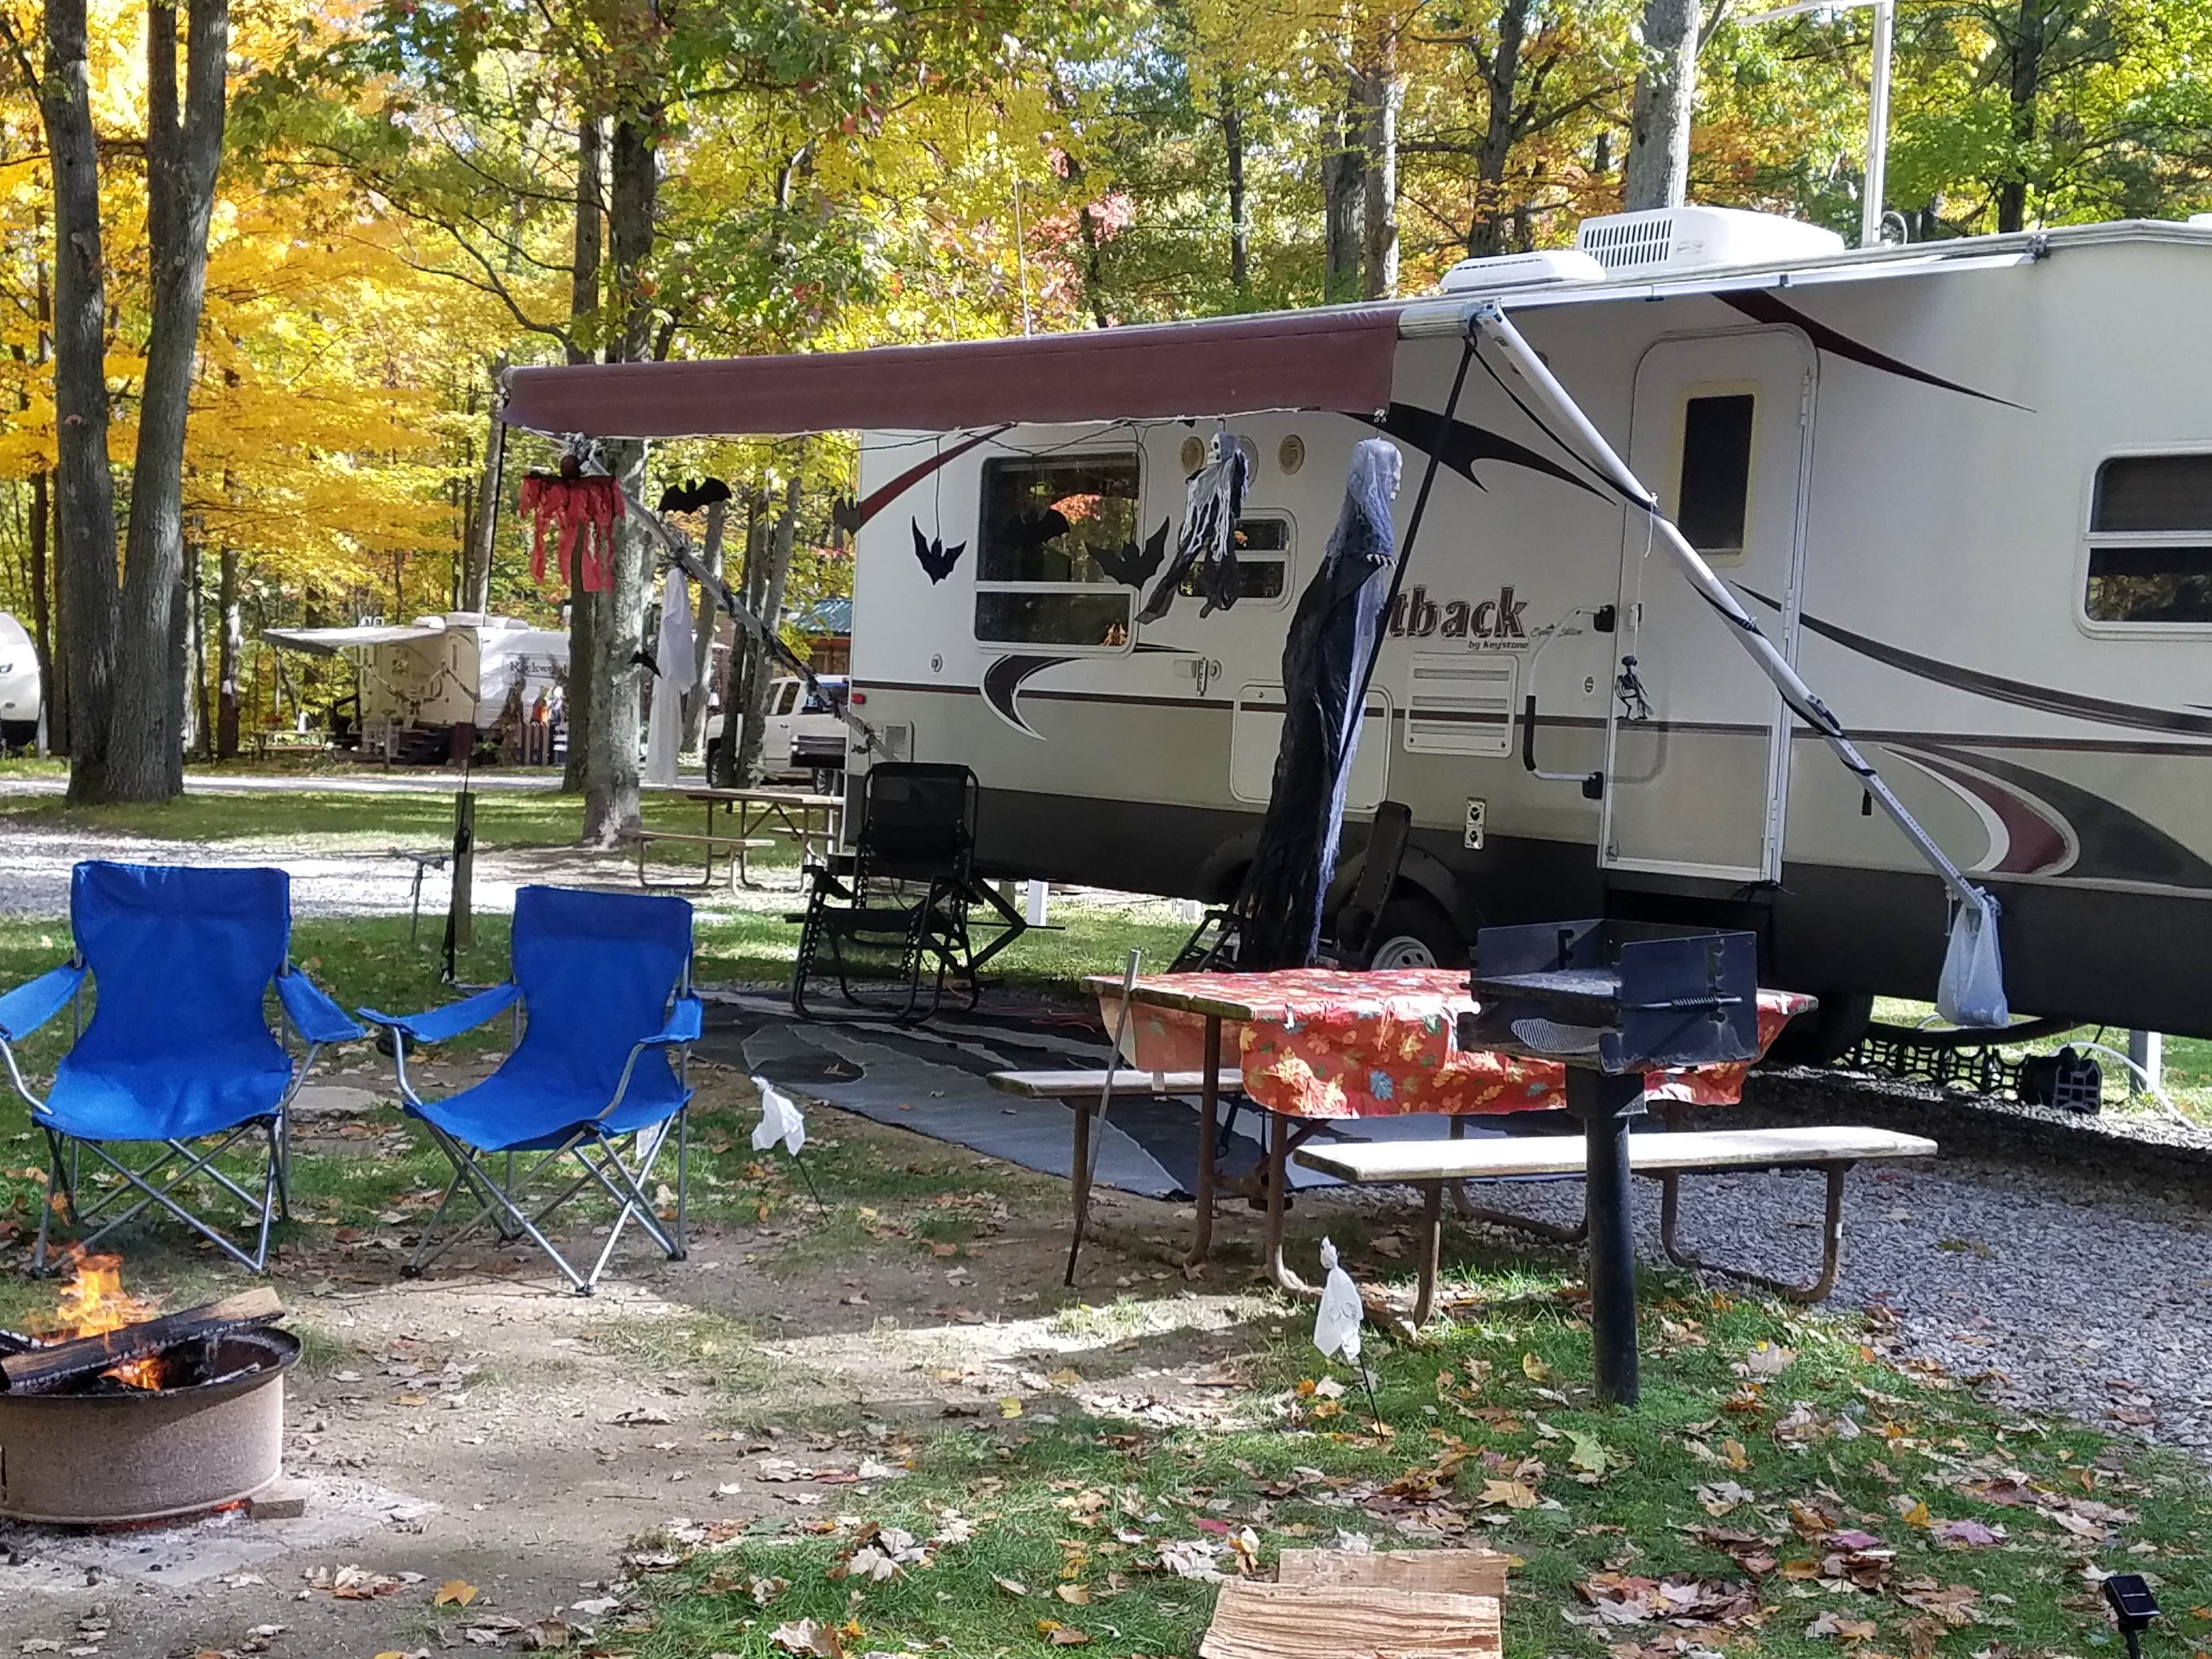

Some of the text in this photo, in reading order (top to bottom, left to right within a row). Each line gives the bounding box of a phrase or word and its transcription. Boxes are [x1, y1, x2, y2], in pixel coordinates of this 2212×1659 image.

[1376, 586, 1528, 638] tback
[1468, 640, 1529, 650] by Keystone
[510, 661, 568, 674] Rckwd
